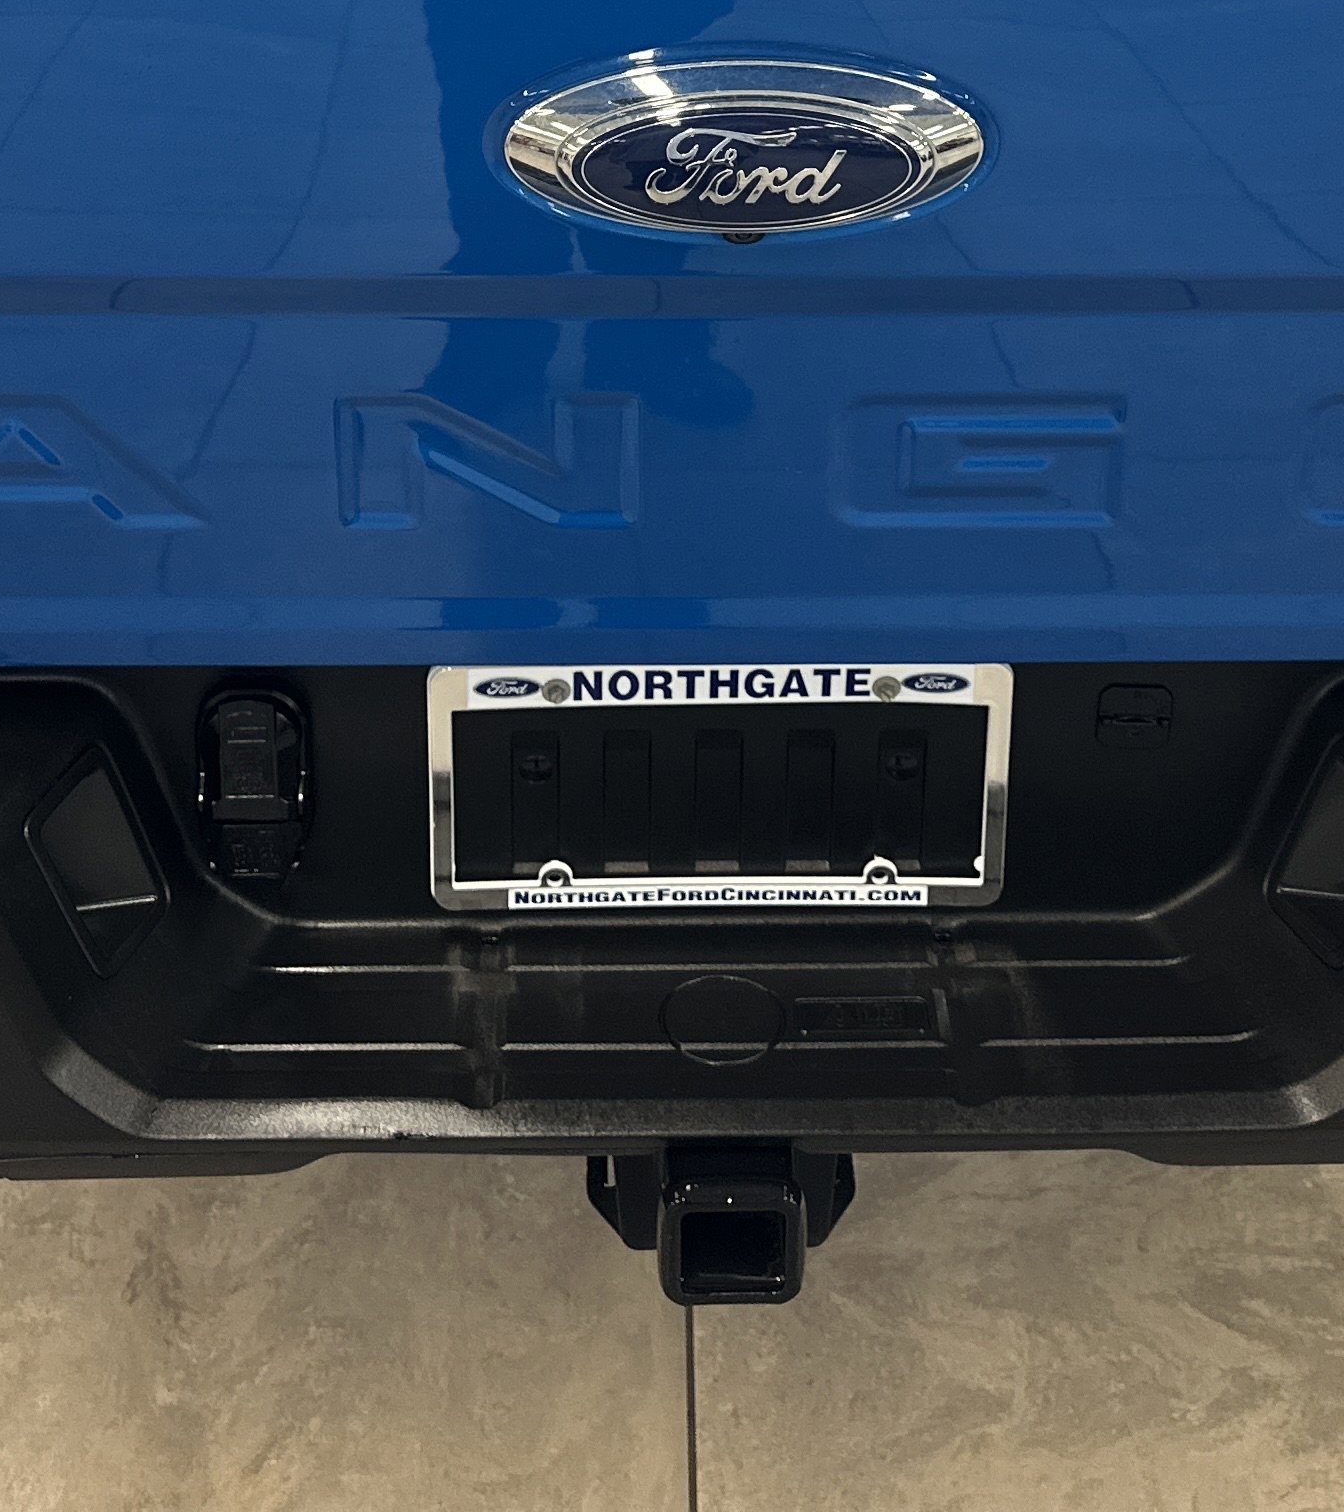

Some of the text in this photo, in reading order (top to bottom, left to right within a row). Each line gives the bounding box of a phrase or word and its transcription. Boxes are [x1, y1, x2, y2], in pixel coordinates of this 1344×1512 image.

[644, 127, 848, 206] Ford
[486, 680, 529, 696] Ford
[572, 668, 871, 702] NORTHGATE
[914, 675, 957, 690] Ford
